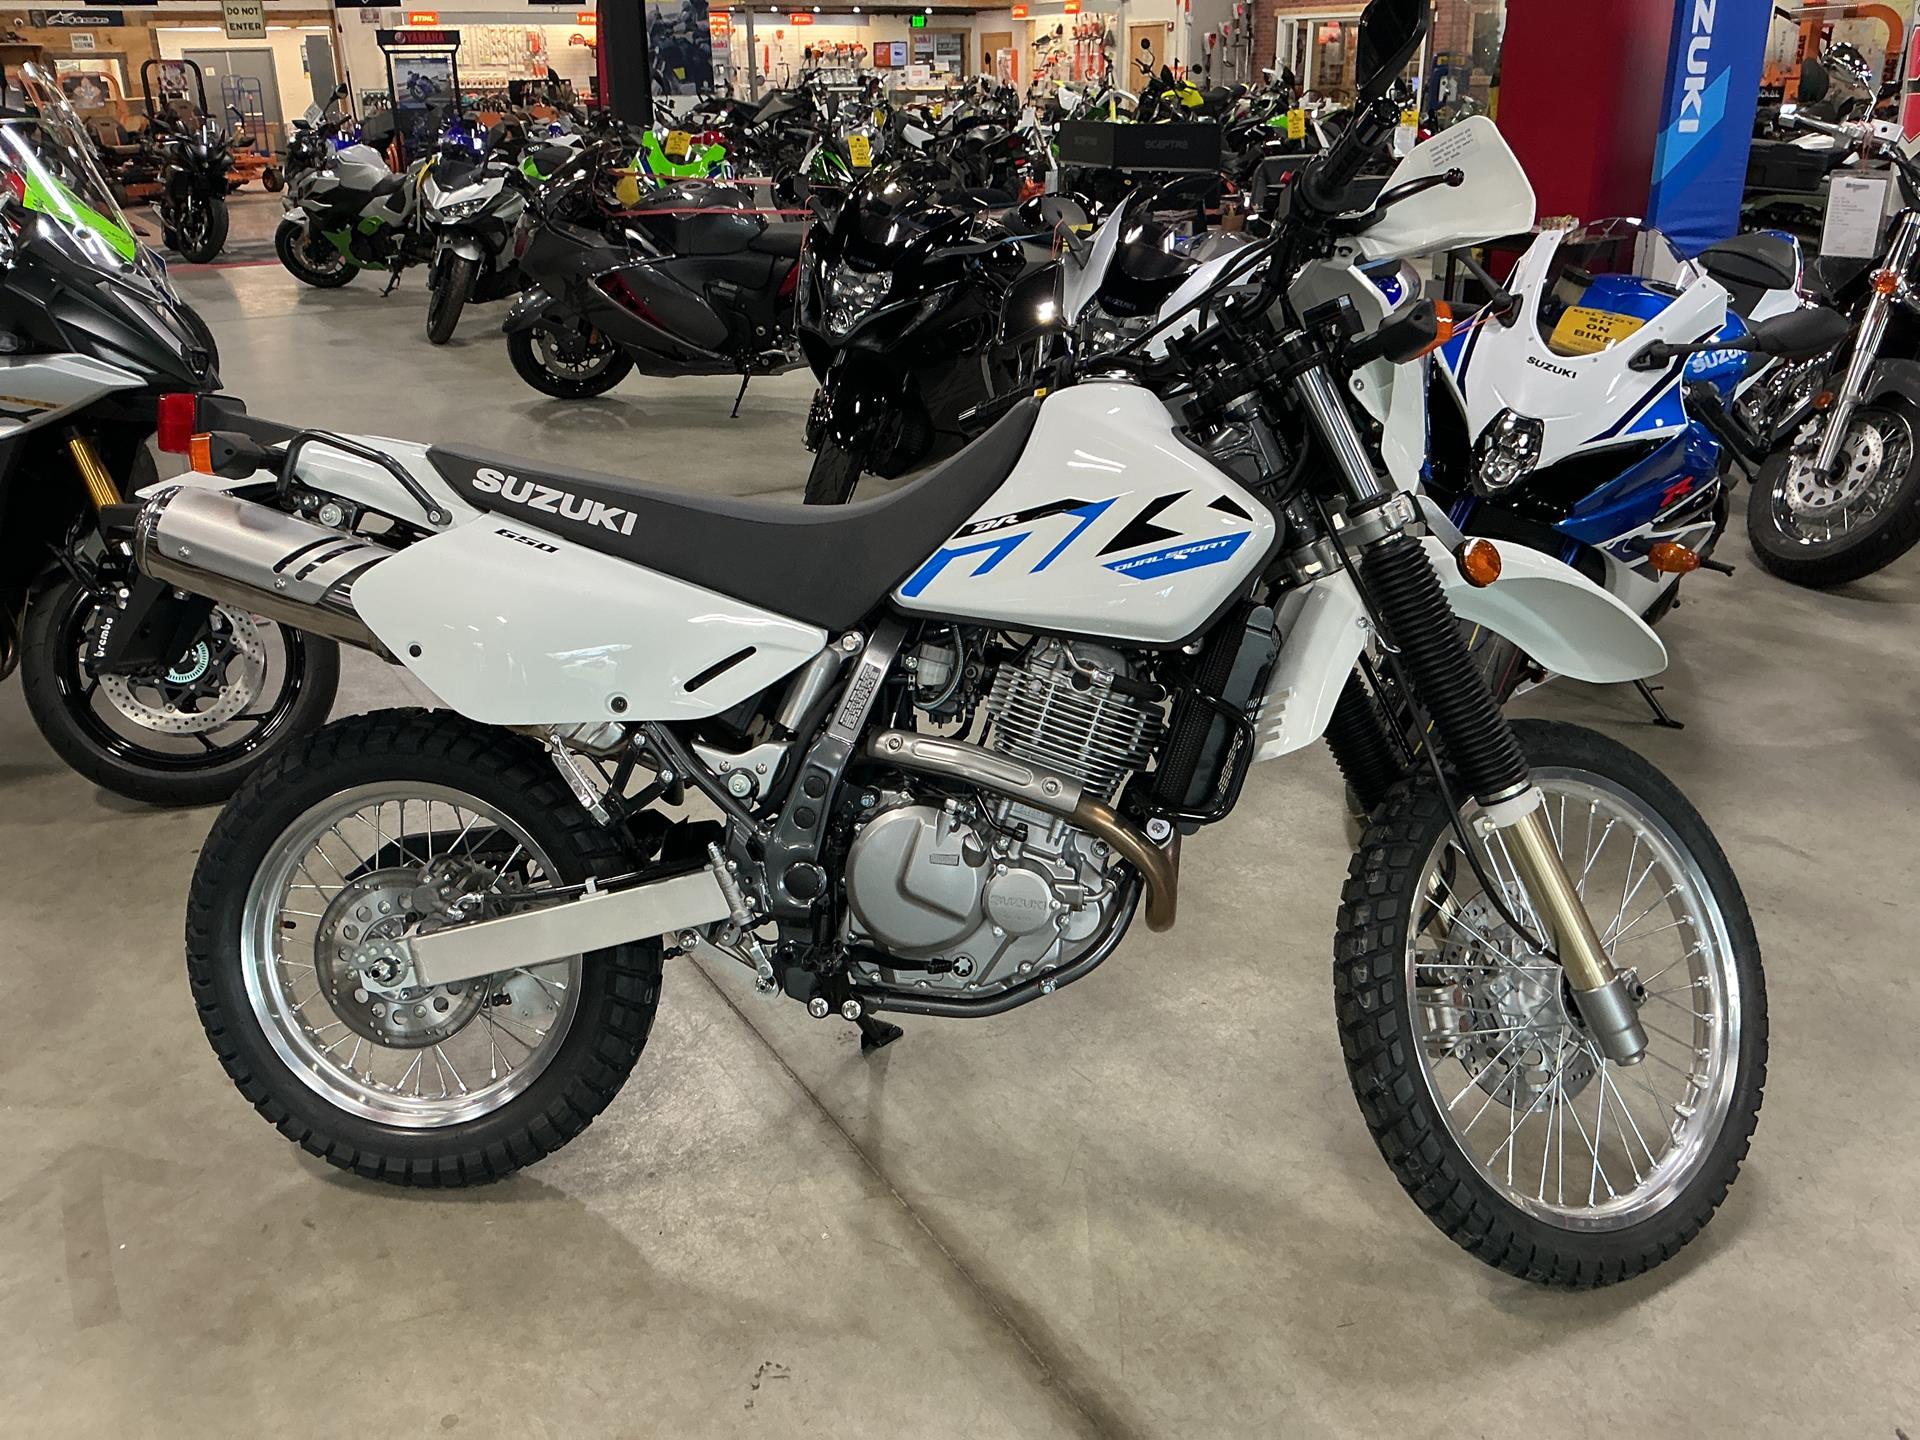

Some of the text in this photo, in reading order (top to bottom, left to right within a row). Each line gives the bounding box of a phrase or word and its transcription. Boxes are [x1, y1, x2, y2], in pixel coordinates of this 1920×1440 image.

[227, 7, 258, 15] DO NOT
[229, 22, 262, 30] ENTER
[405, 32, 445, 43] YAMAHA
[1586, 323, 1610, 334] ON
[1589, 317, 1614, 326] SIT
[1573, 328, 1614, 345] BIKE
[1527, 356, 1577, 379] SUZUKI
[472, 468, 639, 536] SUZUKI
[495, 528, 560, 554] 650
[1113, 539, 1232, 573] DUAL SPORT
[93, 617, 113, 657] brembo
[991, 895, 1047, 911] SUZUKI
